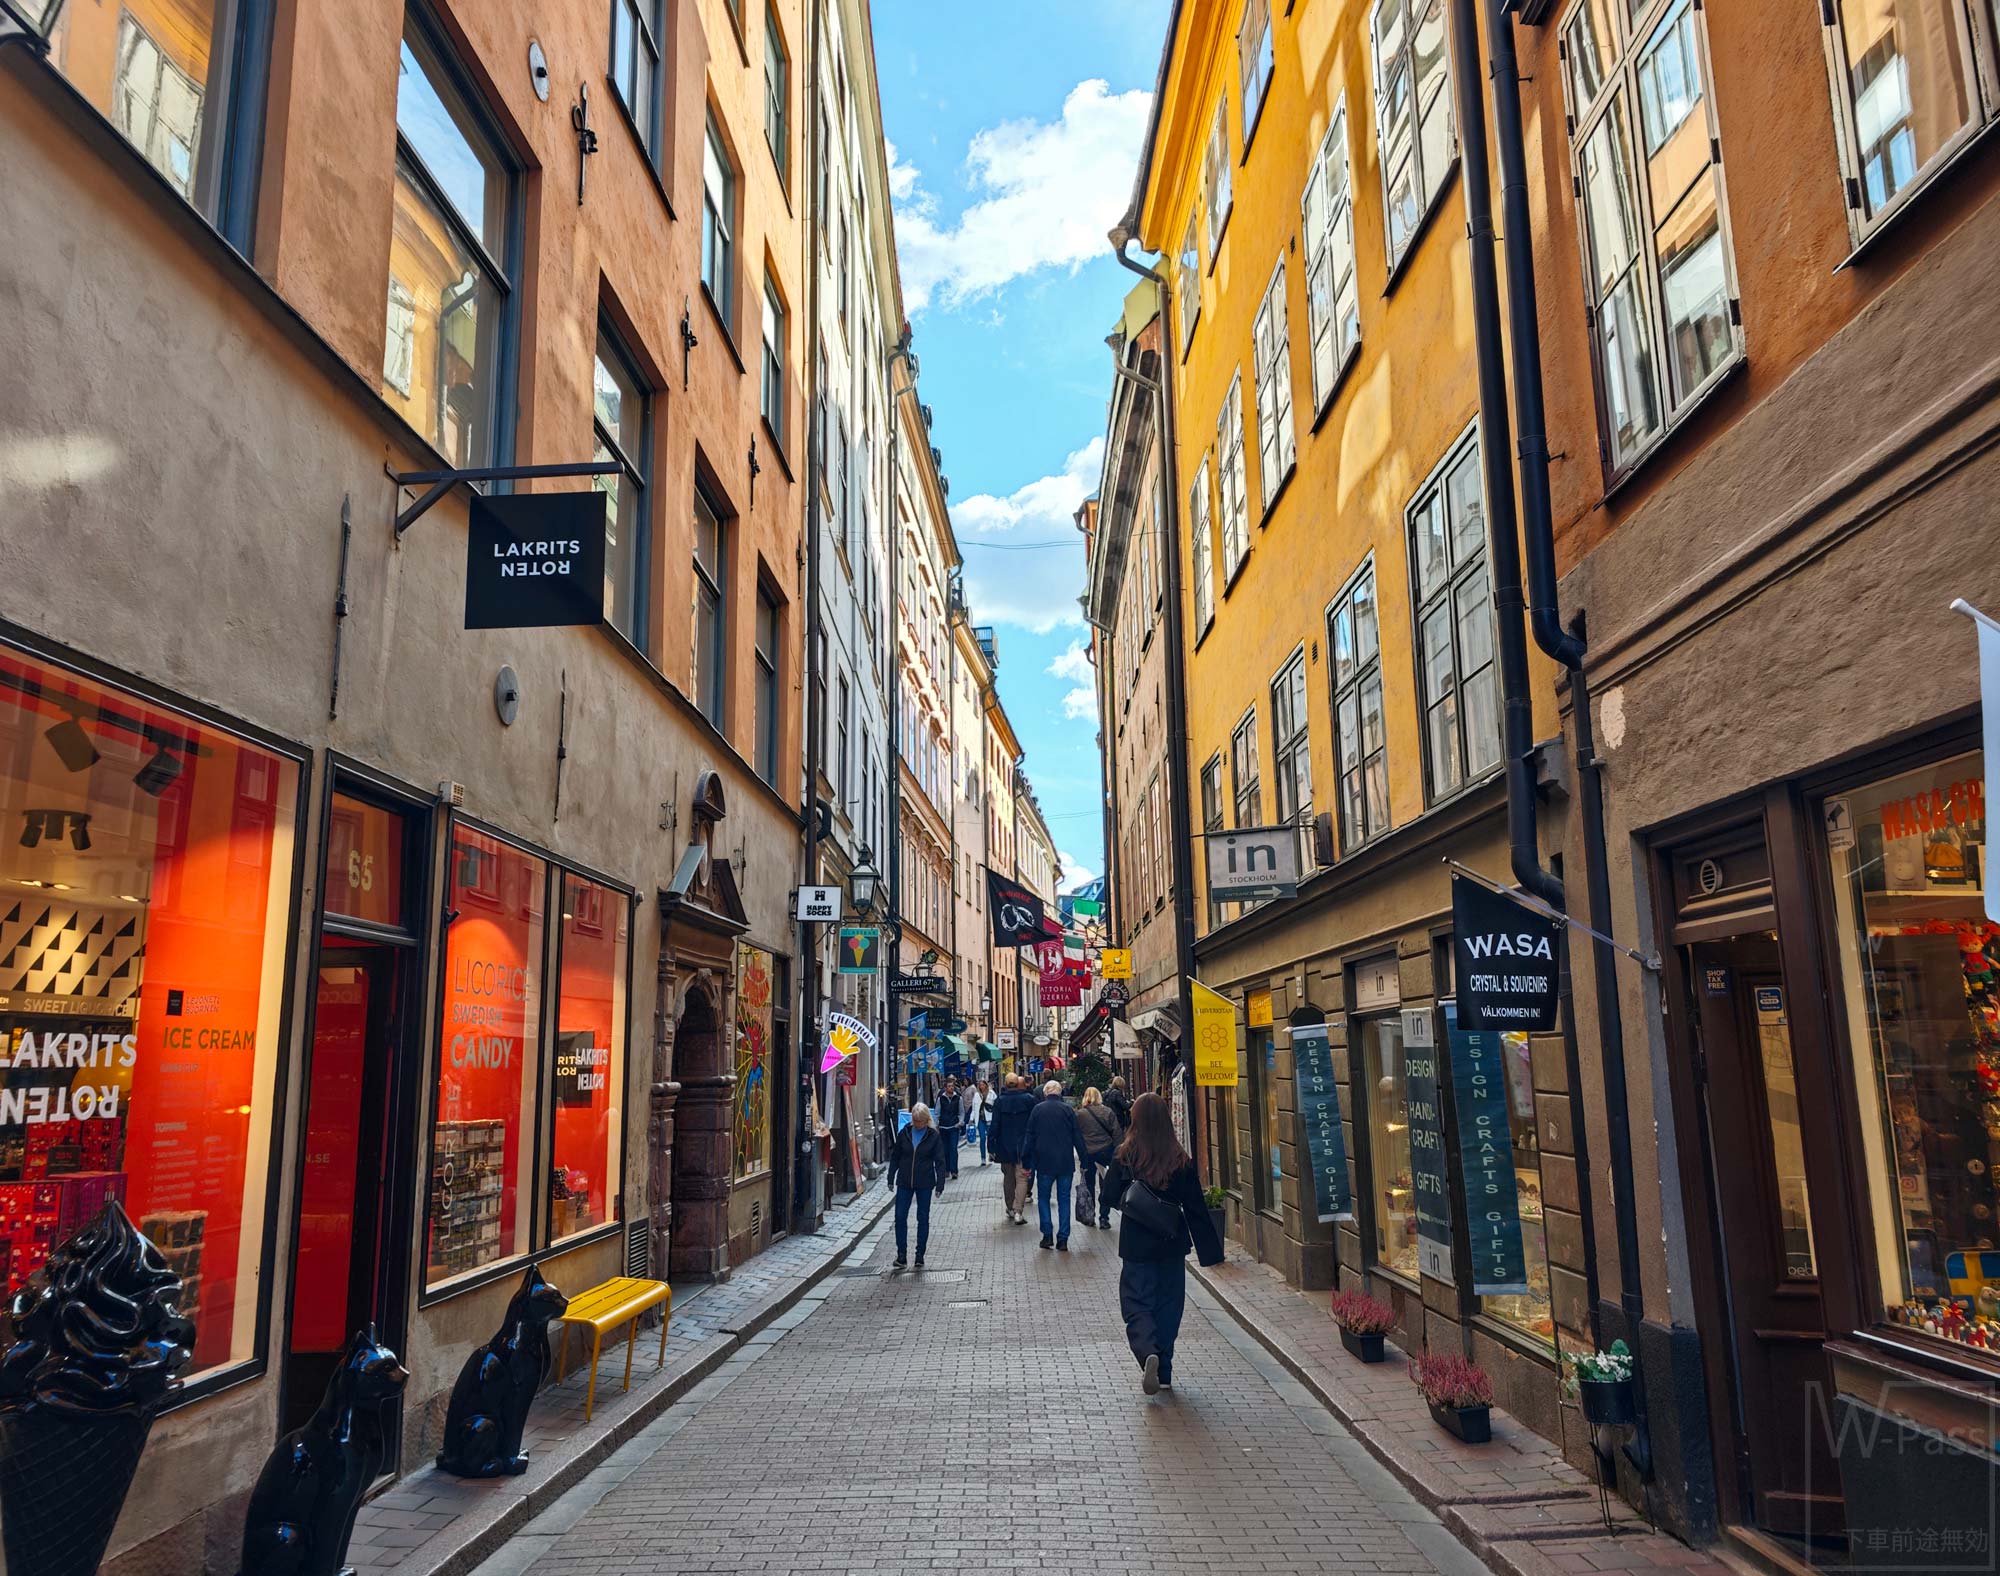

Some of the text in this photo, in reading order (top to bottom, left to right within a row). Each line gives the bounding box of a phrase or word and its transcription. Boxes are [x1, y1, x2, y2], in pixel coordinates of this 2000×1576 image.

[494, 540, 580, 557] LAKRITS
[501, 561, 571, 577] ROTEN
[1881, 788, 1947, 841] WASA
[1226, 838, 1277, 873] in
[349, 850, 372, 891] 65
[1228, 874, 1277, 884] STOCKHOLM
[1464, 933, 1552, 960] WASA
[455, 957, 530, 1001] LICORICE
[891, 979, 922, 987] GALLERI
[1375, 970, 1385, 992] in
[1470, 975, 1547, 993] CRYSTAL & SOUVENIRS
[23, 998, 68, 1013] SWEET
[452, 1004, 502, 1026] SWEDISH
[1481, 1005, 1529, 1018] VÄLKOMMEN
[831, 1014, 875, 1045] CHURROS
[1411, 1011, 1424, 1036] in
[0, 1032, 138, 1068] LAKRITS
[163, 1027, 255, 1050] ICE CREAM
[451, 1034, 514, 1069] CANDY
[575, 1047, 609, 1065] LAKRITS
[1210, 1060, 1223, 1068] BEE
[1406, 1059, 1435, 1078] DESIGN
[577, 1073, 605, 1090] ROTEN
[1198, 1073, 1235, 1081] WELCOME
[0, 1085, 120, 1125] ROTEN
[1307, 1040, 1339, 1210] DESIGN CRAFTS GIFTS
[1412, 1128, 1440, 1150] CRAFT
[1475, 1115, 1500, 1194] CRAFTS
[1416, 1171, 1442, 1195] GIFTS
[1486, 1211, 1507, 1278] GIFTS
[1428, 1245, 1441, 1273] in
